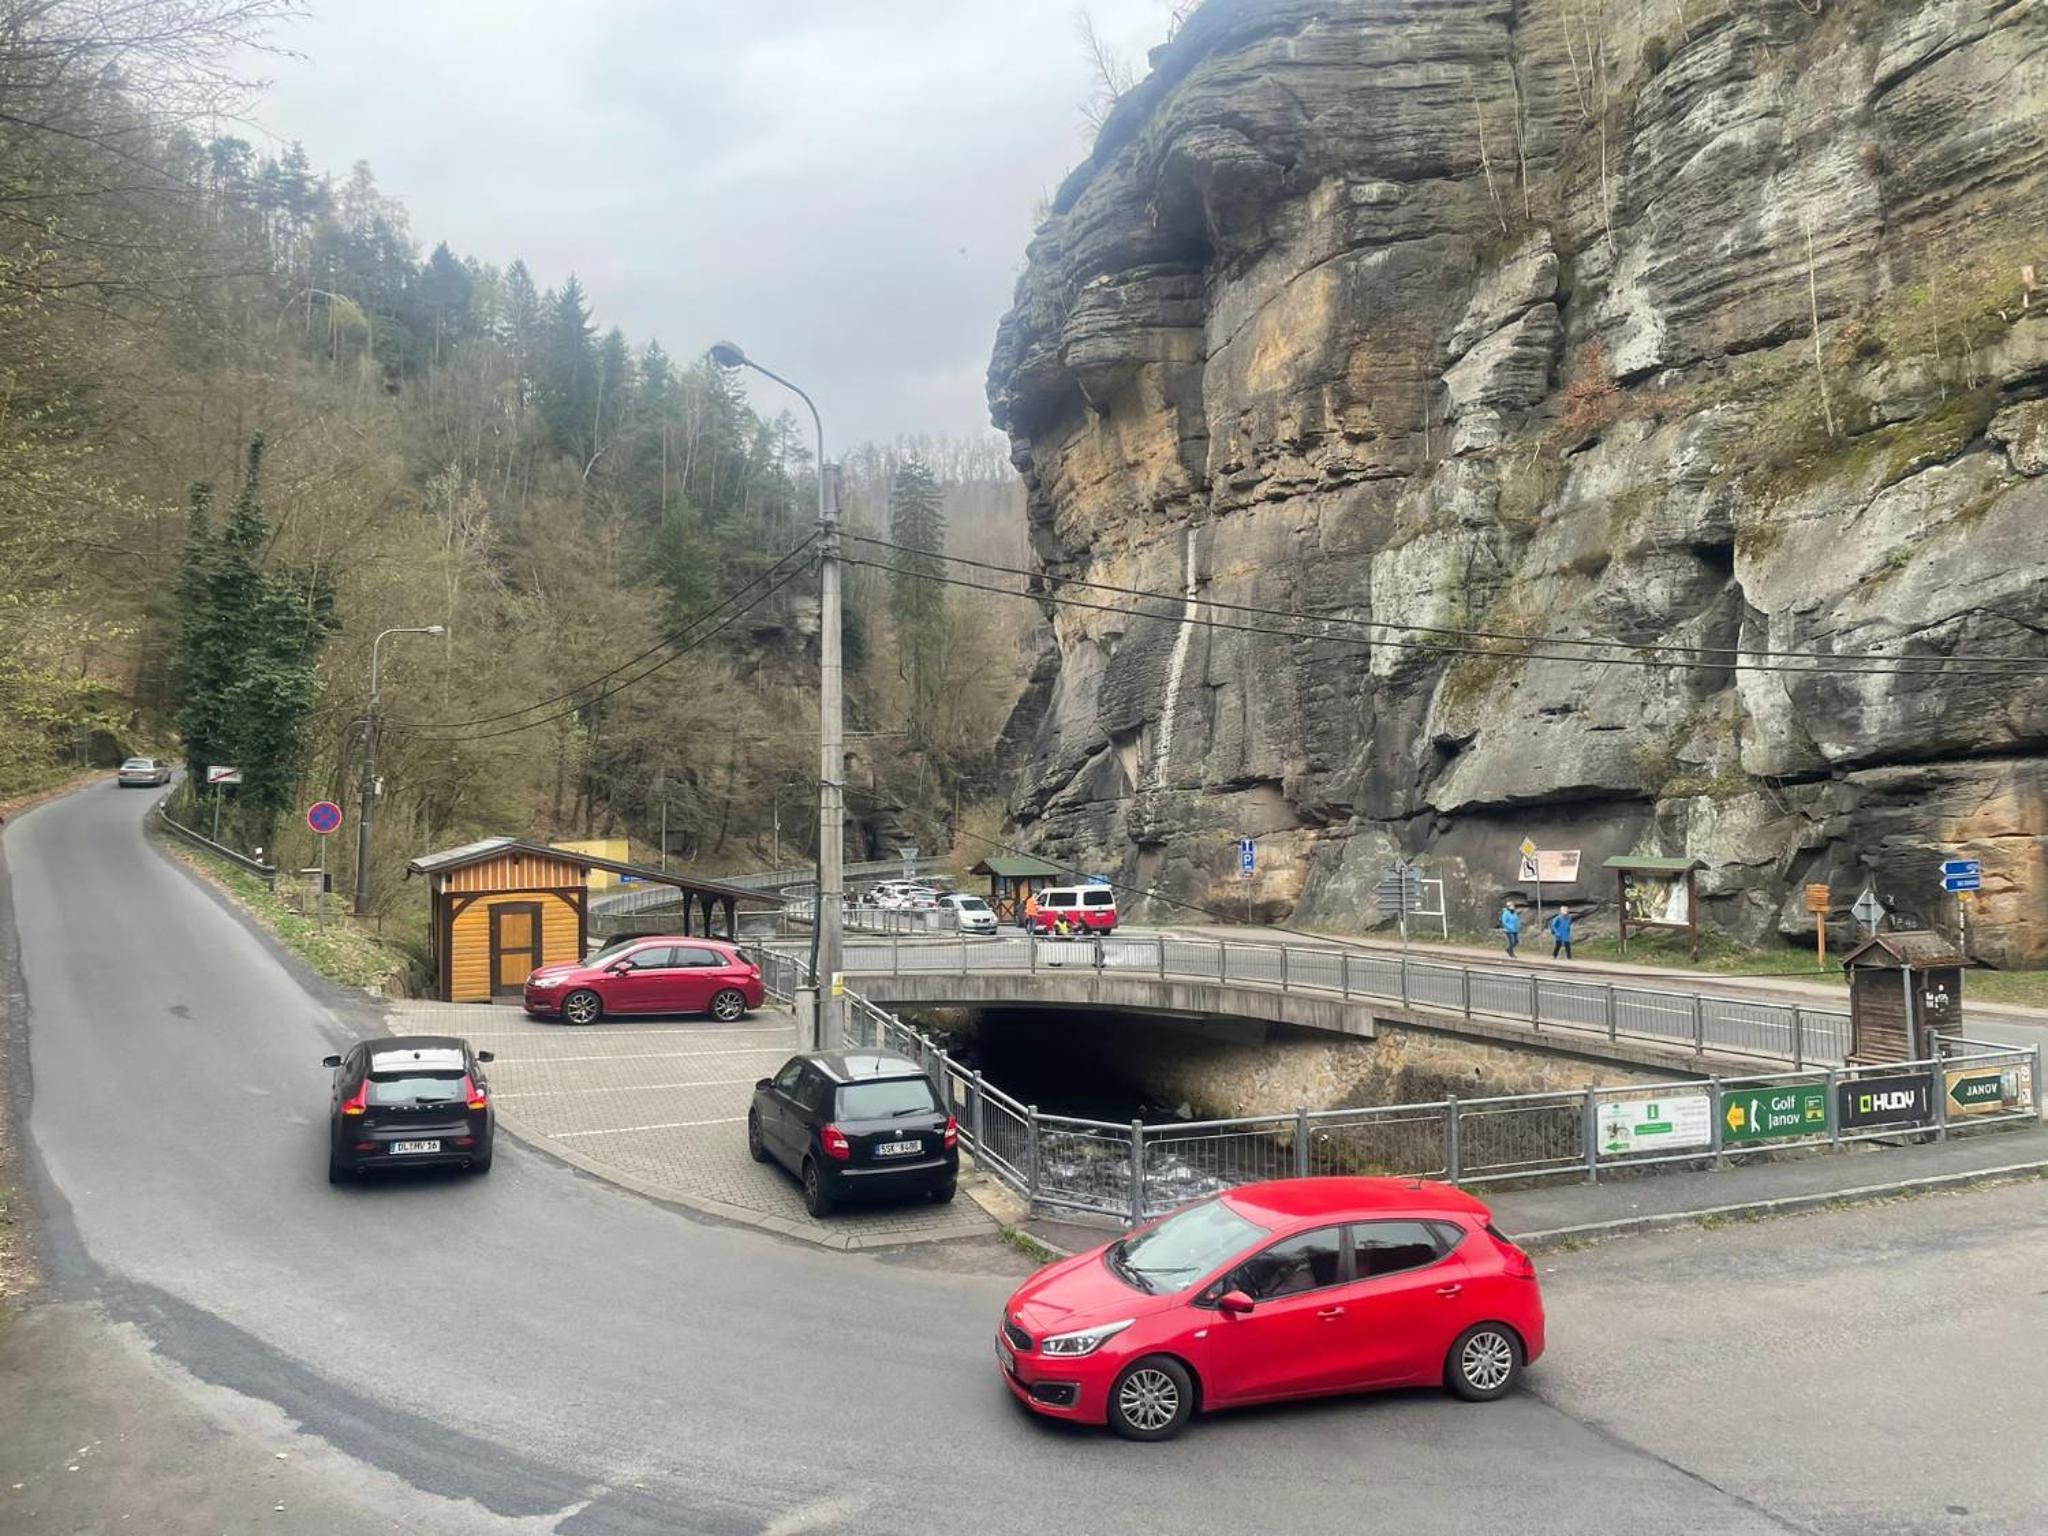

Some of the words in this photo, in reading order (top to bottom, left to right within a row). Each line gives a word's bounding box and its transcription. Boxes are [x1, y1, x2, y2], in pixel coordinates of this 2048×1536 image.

[1243, 854, 1252, 865] P
[1966, 1082, 1998, 1097] JANOV
[1770, 1094, 1797, 1111] Golf
[1872, 1089, 1915, 1112] HUDY
[1768, 1113, 1801, 1130] Janov
